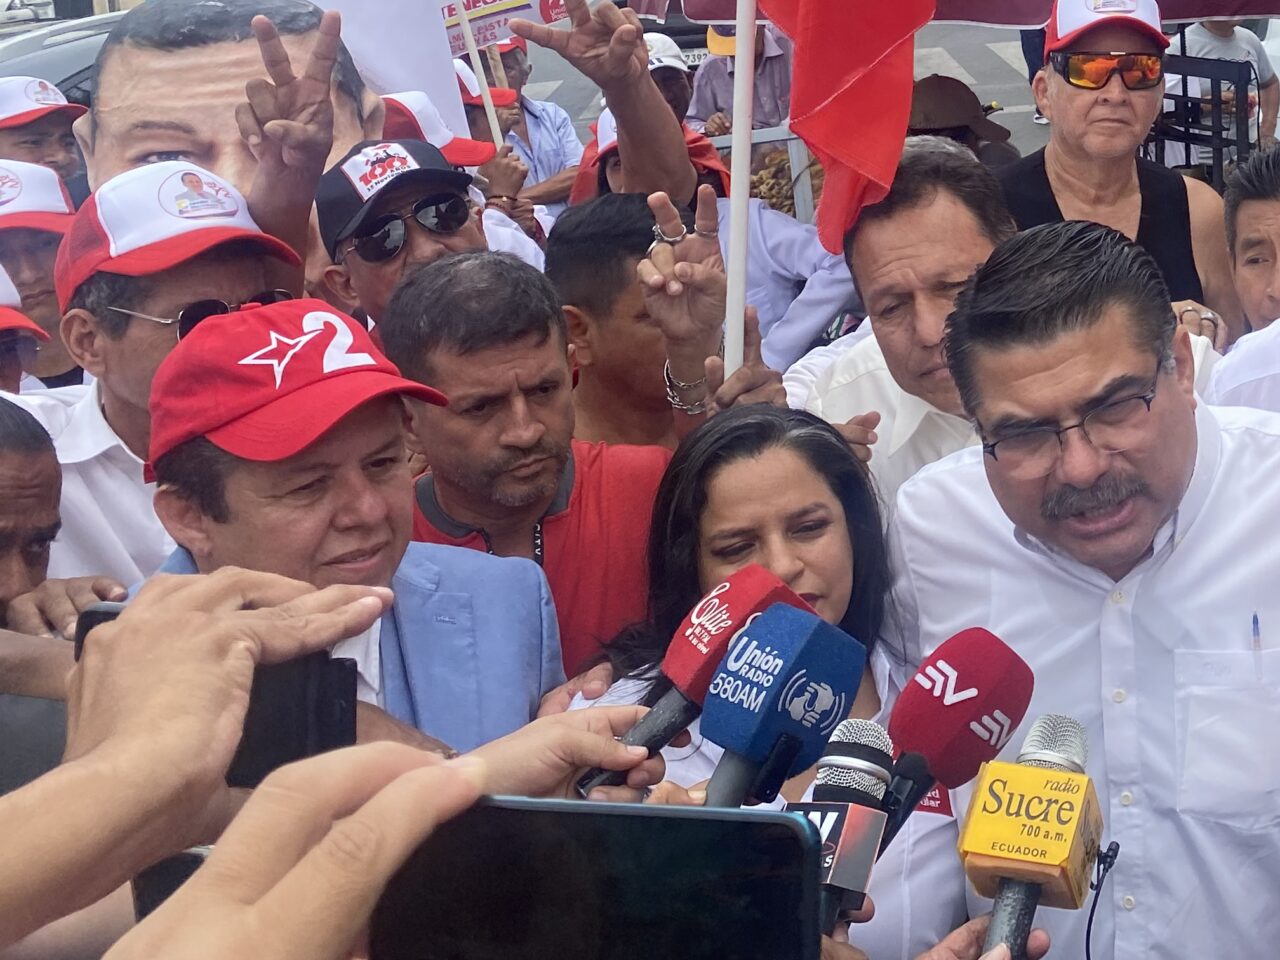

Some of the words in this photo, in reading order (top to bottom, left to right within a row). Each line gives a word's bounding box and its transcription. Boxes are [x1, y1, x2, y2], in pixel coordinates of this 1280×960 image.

[359, 155, 408, 187] 100
[302, 311, 377, 373] 2
[726, 636, 784, 676] Unión
[738, 664, 774, 687] RADIO
[709, 672, 767, 713] 580AM
[982, 778, 1075, 826] Sucre
[1043, 777, 1080, 795] radio
[1020, 823, 1041, 838] 700
[1043, 829, 1067, 842] a.m.
[991, 841, 1048, 859] ECUADOR
